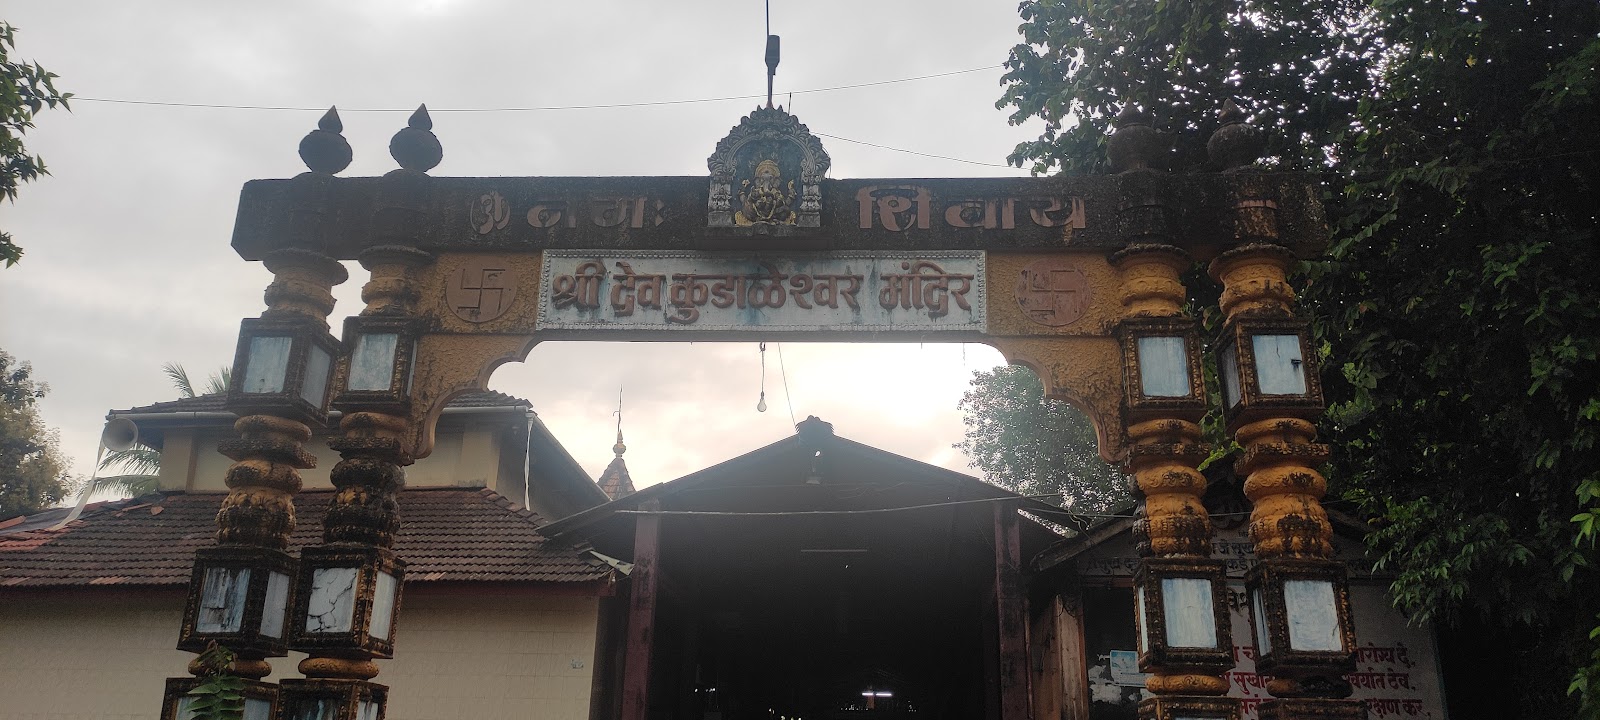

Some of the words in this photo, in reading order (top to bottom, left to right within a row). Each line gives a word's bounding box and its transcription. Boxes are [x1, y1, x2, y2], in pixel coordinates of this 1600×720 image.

[855, 184, 1087, 232] शिवाय
[551, 261, 607, 311] श्री
[878, 261, 975, 318] मंदिर
